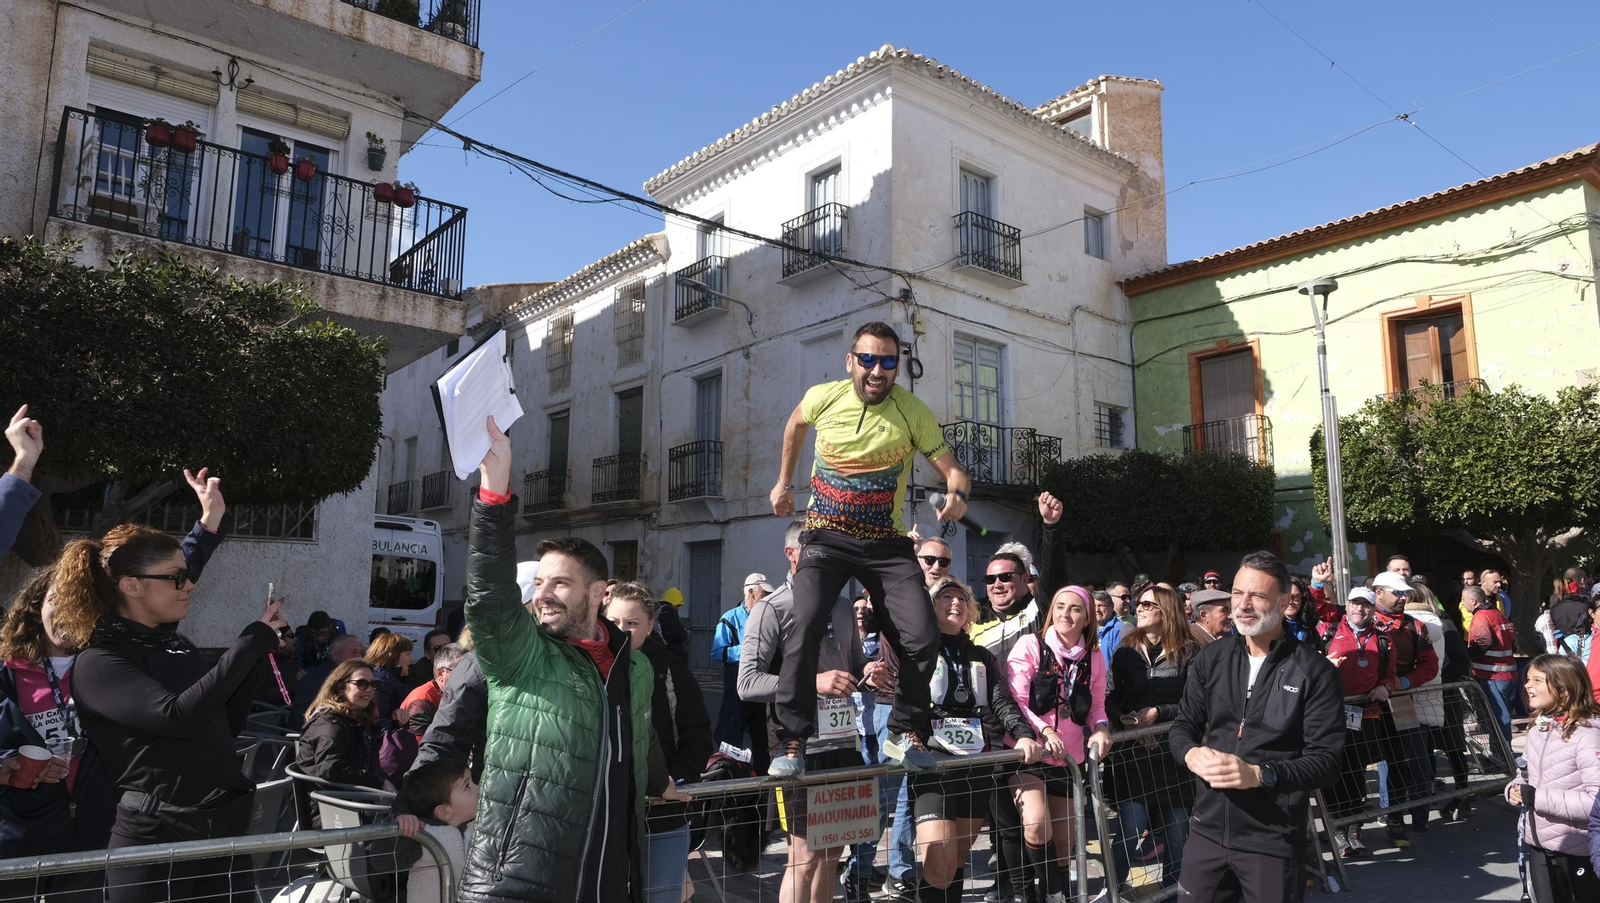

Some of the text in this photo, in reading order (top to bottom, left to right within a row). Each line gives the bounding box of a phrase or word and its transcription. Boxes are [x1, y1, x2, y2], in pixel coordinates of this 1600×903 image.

[372, 540, 428, 555] BULANCIA
[829, 710, 852, 728] 372
[943, 730, 975, 745] 352
[814, 783, 873, 805] ALYSER DE
[808, 804, 878, 827] MAQUINARIA
[822, 834, 839, 845] 950
[841, 831, 856, 841] 453
[858, 828, 874, 839] 550
